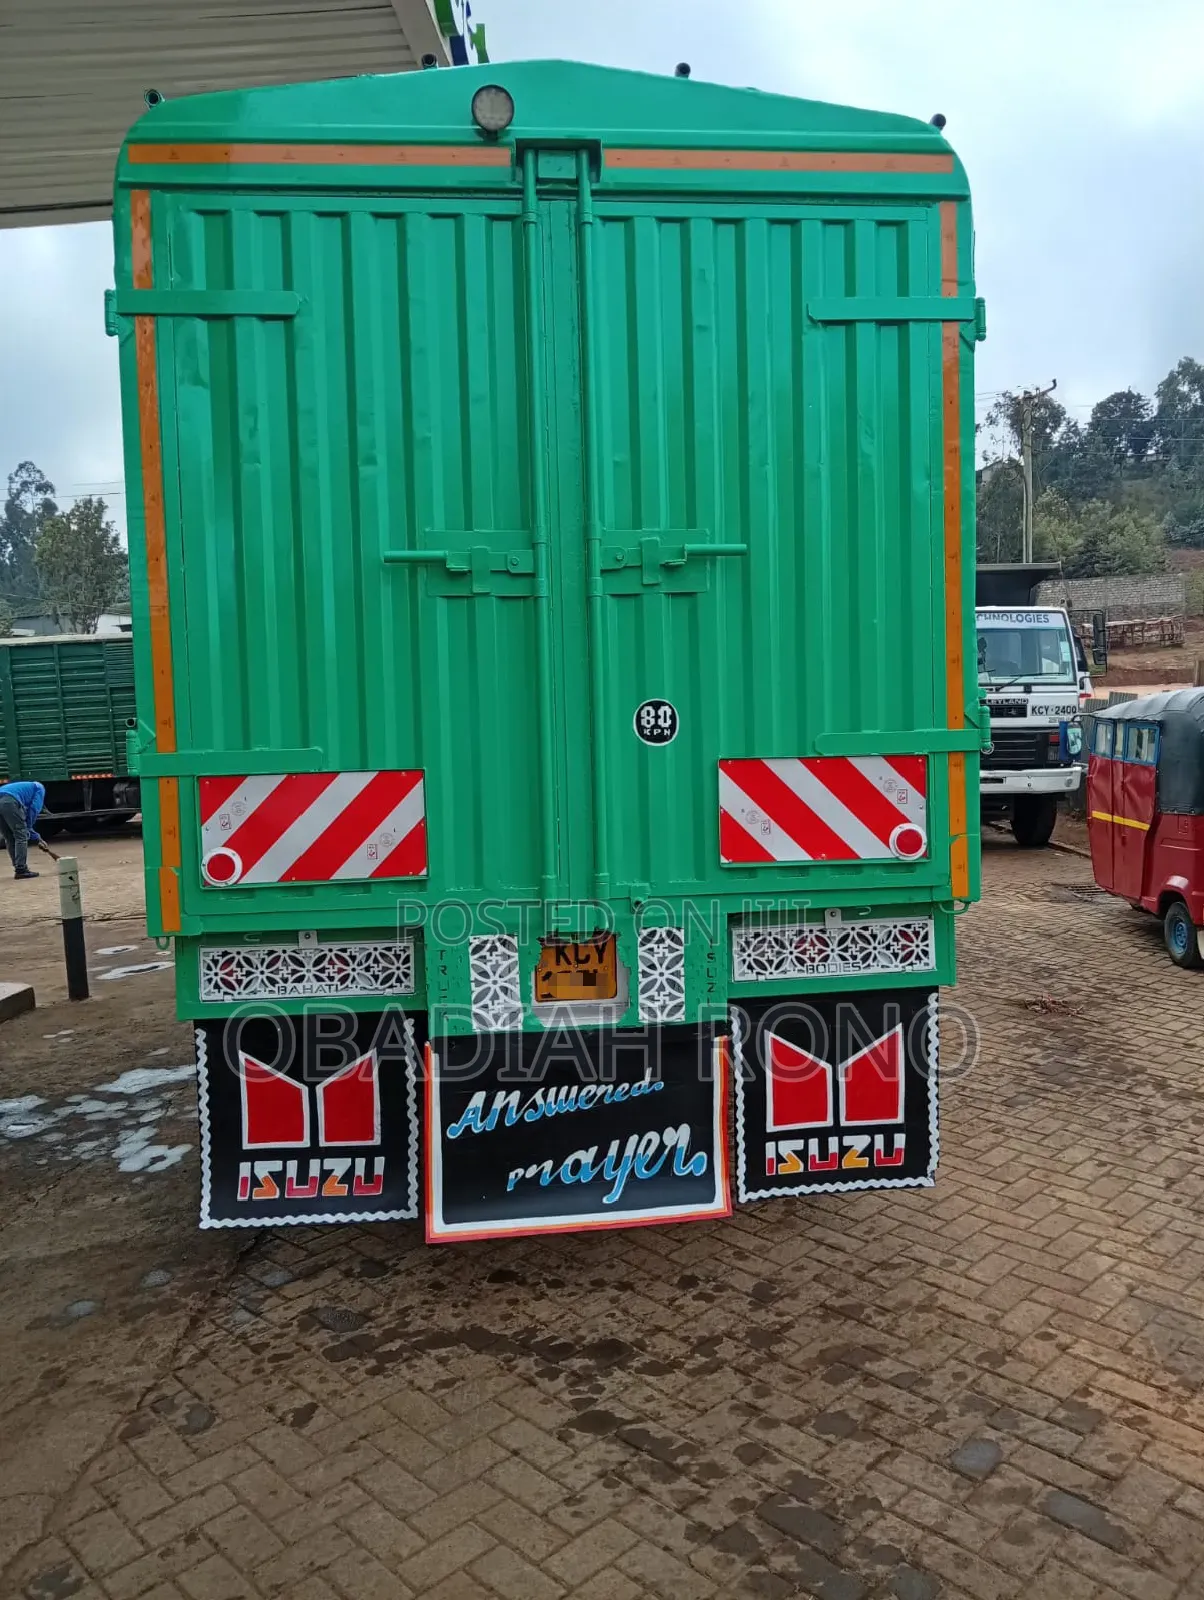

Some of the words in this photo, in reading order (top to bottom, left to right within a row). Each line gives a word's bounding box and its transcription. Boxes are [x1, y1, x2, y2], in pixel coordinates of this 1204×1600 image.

[641, 705, 672, 728] 80
[1031, 705, 1050, 715] KCY
[806, 961, 862, 974] BODIES
[277, 983, 339, 995] BAHATI
[765, 1132, 906, 1177] ISUZU
[237, 1156, 385, 1201] ISUZU
